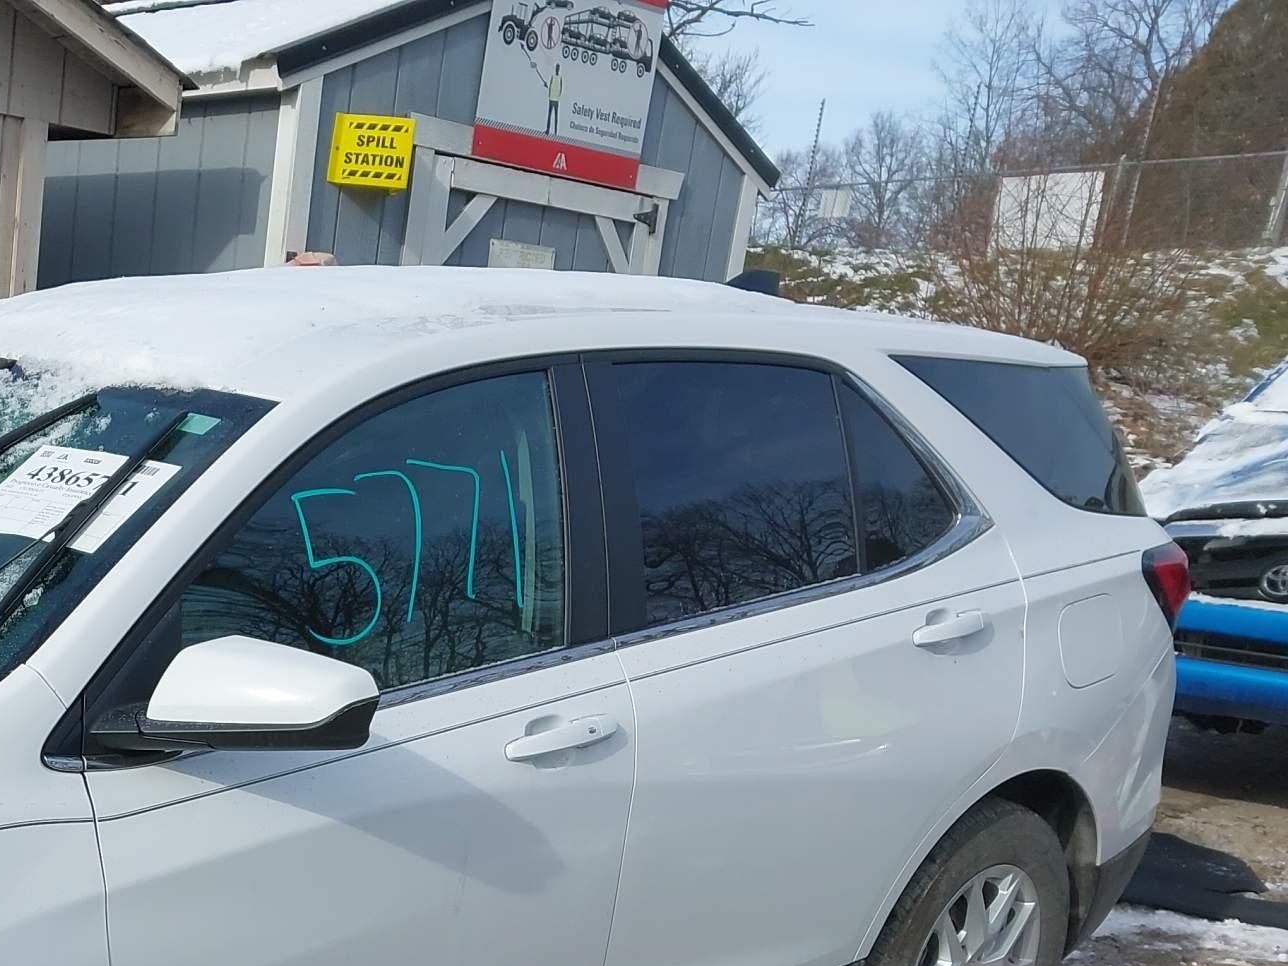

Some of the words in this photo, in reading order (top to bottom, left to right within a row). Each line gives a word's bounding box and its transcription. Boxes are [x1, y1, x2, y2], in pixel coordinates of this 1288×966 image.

[572, 102, 594, 120] Safety
[596, 107, 611, 123] Vest
[612, 111, 642, 130] Required
[356, 134, 397, 150] SPILL
[343, 151, 405, 169] STATION
[26, 465, 138, 497] 4386571
[291, 449, 524, 646] 5771
